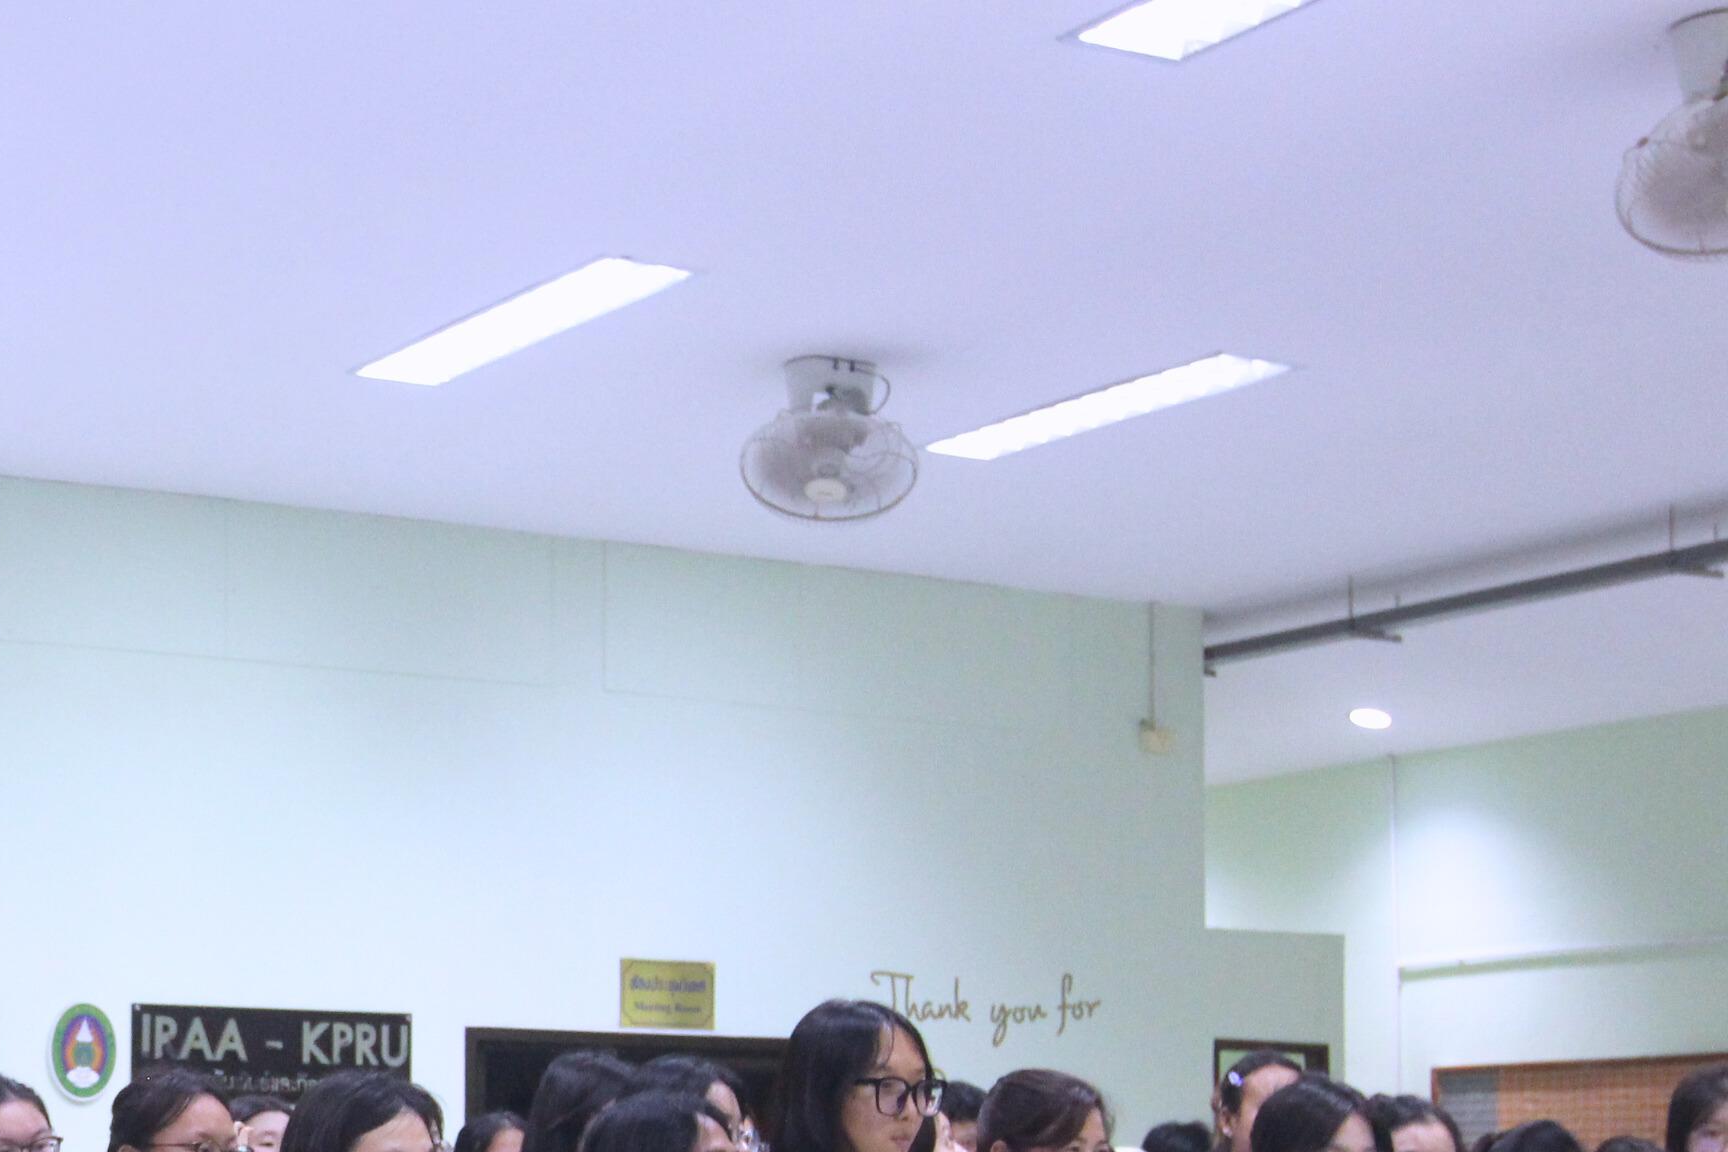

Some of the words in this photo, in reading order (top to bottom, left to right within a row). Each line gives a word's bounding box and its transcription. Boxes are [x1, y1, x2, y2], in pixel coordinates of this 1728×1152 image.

[141, 1013, 248, 1062] IPAA
[302, 1020, 409, 1067] KPRU
[871, 971, 971, 1022] Thank
[990, 1000, 1048, 1048] you
[1057, 973, 1101, 1036] for
